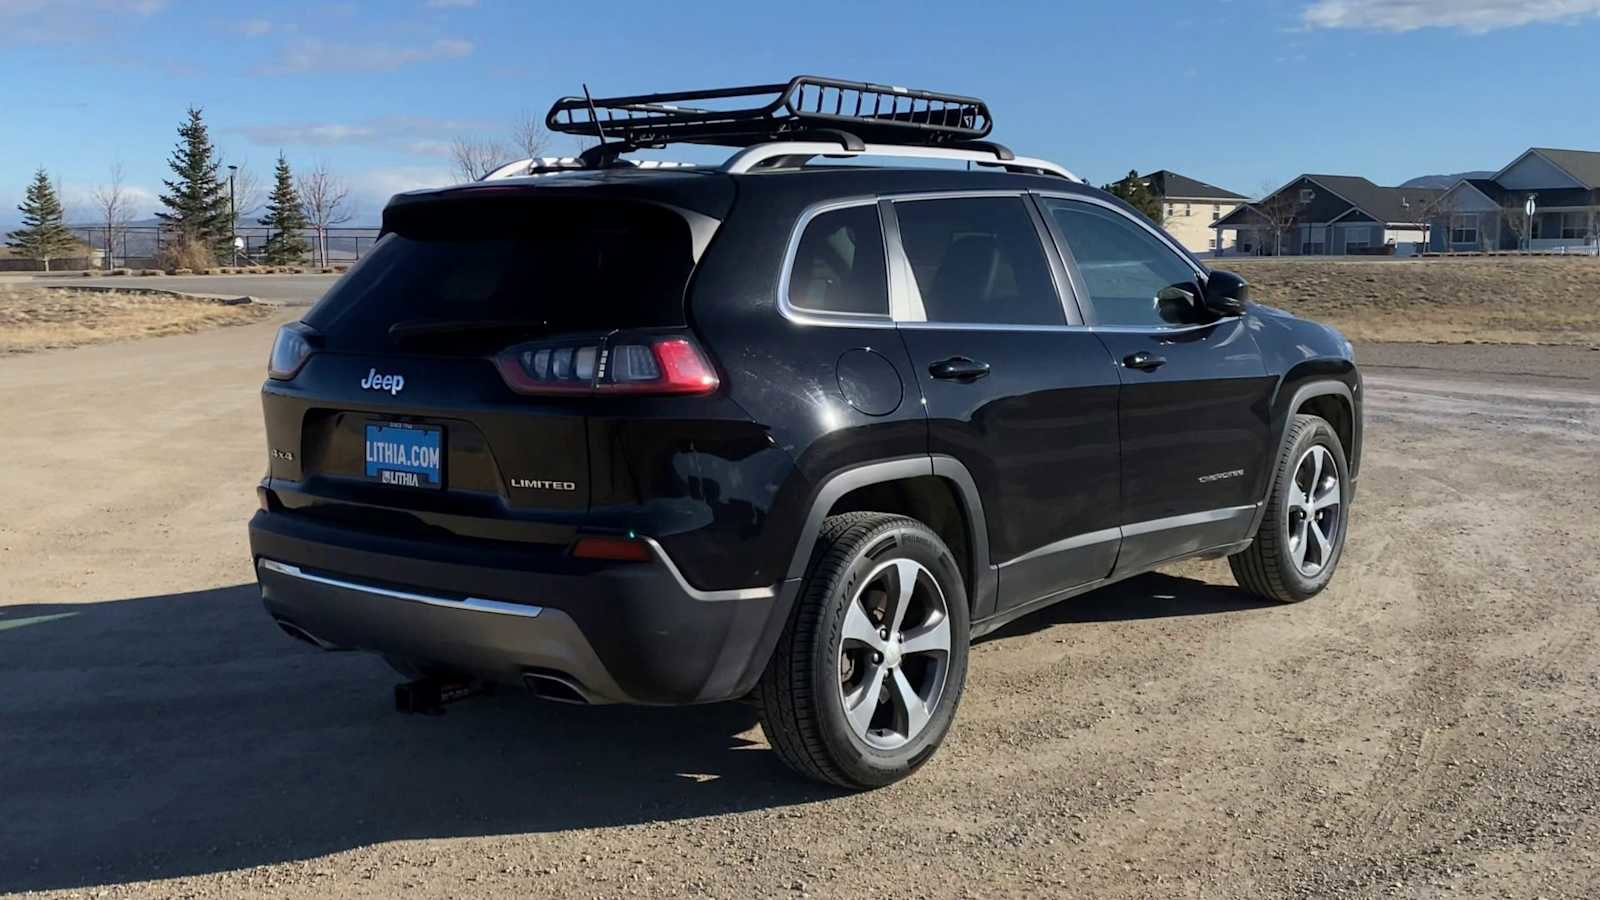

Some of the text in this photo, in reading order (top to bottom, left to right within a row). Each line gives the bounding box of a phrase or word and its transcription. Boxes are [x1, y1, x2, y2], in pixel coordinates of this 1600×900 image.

[361, 368, 405, 395] Jeep
[366, 441, 440, 469] LITHIA.COM
[391, 471, 419, 487] LITHIA
[511, 478, 576, 491] LIMITED
